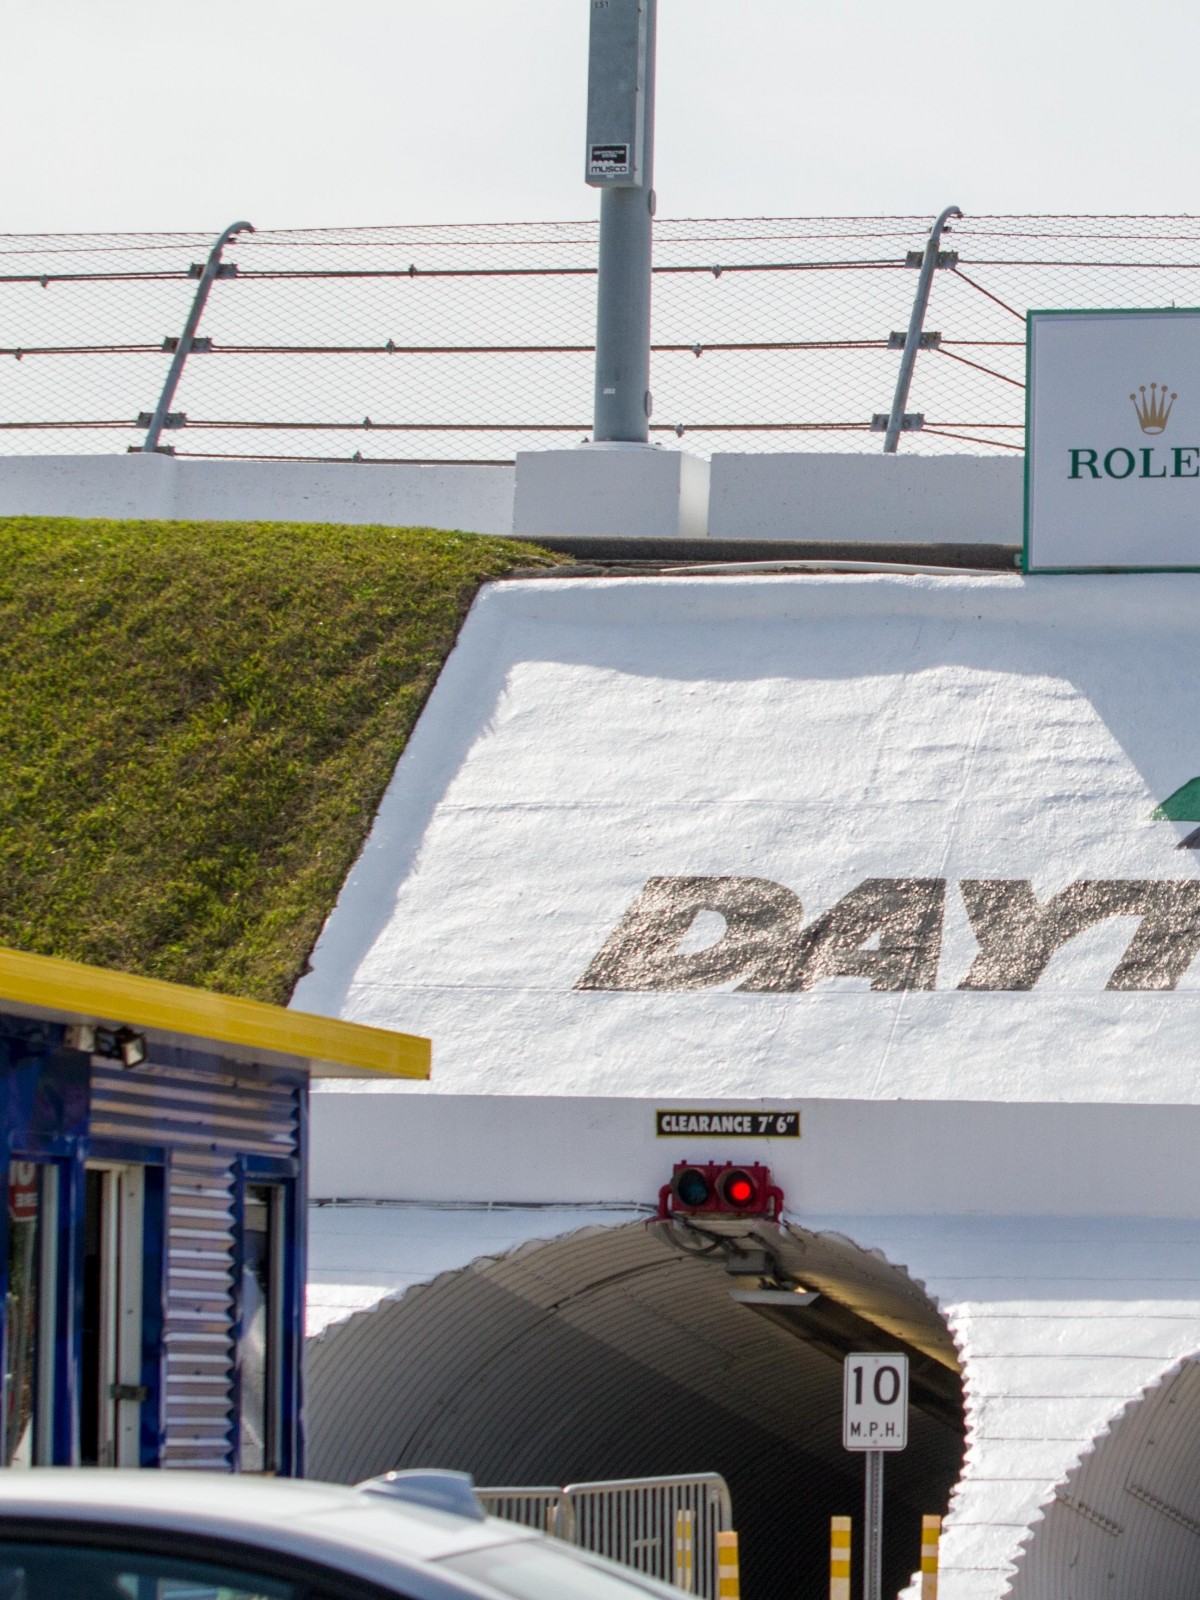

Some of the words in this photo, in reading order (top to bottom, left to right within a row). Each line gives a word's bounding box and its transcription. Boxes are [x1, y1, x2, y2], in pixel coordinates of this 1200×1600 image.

[661, 1115, 752, 1132] CLEARANCE
[853, 1365, 900, 1406] 10
[850, 1422, 900, 1437] M.P.H.
